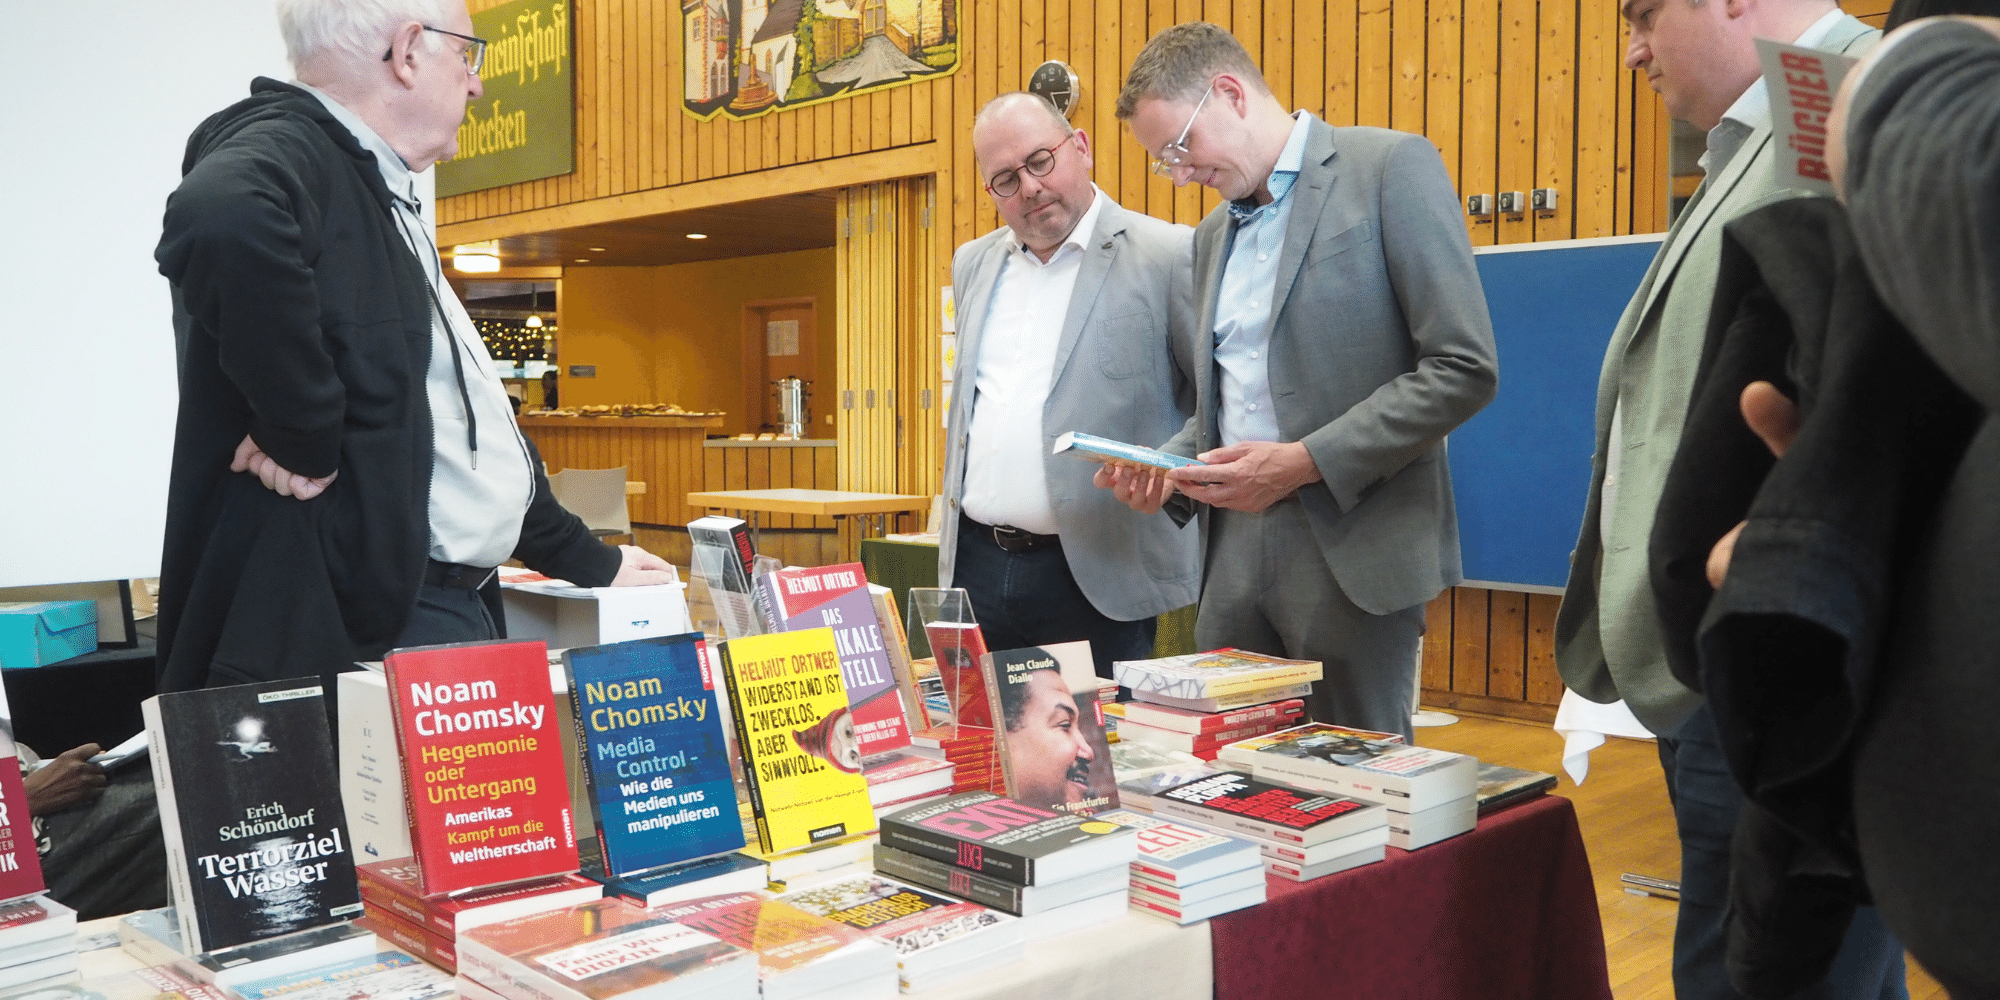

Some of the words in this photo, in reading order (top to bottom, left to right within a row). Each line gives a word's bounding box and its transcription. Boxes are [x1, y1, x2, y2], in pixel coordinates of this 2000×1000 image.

[1779, 52, 1832, 181] BÜCHER
[786, 575, 822, 595] HELMUT
[823, 571, 858, 591] ORTNER
[821, 608, 843, 626] DAS
[835, 625, 882, 657] IKALE
[698, 648, 710, 684] nomen
[738, 657, 787, 683] HELMUT
[791, 651, 837, 675] ORTNER
[843, 657, 885, 689] TELL
[1006, 662, 1026, 673] Jean
[1026, 657, 1055, 670] Claude
[1007, 673, 1034, 685] Diallo
[410, 680, 497, 707] Noam
[585, 677, 663, 705] Noam
[743, 677, 823, 708] WIDERSTAND
[824, 674, 841, 694] IST
[415, 700, 545, 736] Chomsky
[590, 696, 707, 732] Chomsky
[750, 702, 821, 732] ZWECKLOS.
[421, 734, 538, 764] Hegemonie
[596, 736, 656, 761] Media
[757, 733, 789, 758] ABER
[424, 765, 466, 783] oder
[616, 750, 686, 778] Control
[761, 753, 825, 782] SINNVOLL.
[427, 776, 537, 804] Untergang
[620, 780, 649, 797] Wie
[650, 775, 674, 792] die
[246, 801, 285, 819] Erich
[445, 806, 513, 827] Amerikas
[624, 795, 677, 815] Medien
[678, 790, 705, 803] uns
[219, 808, 315, 841] Schöndorf
[447, 825, 496, 845] Kampf
[498, 824, 521, 837] um
[523, 819, 544, 833] die
[562, 808, 574, 848] nomen
[627, 806, 720, 834] manipulieren
[919, 798, 1059, 841] EXIT
[198, 828, 345, 879] Terrorziel
[449, 836, 558, 865] Weltherrschaft
[956, 841, 983, 871] EXIT
[223, 861, 328, 899] Wasser
[571, 946, 662, 976] DIOXIN
